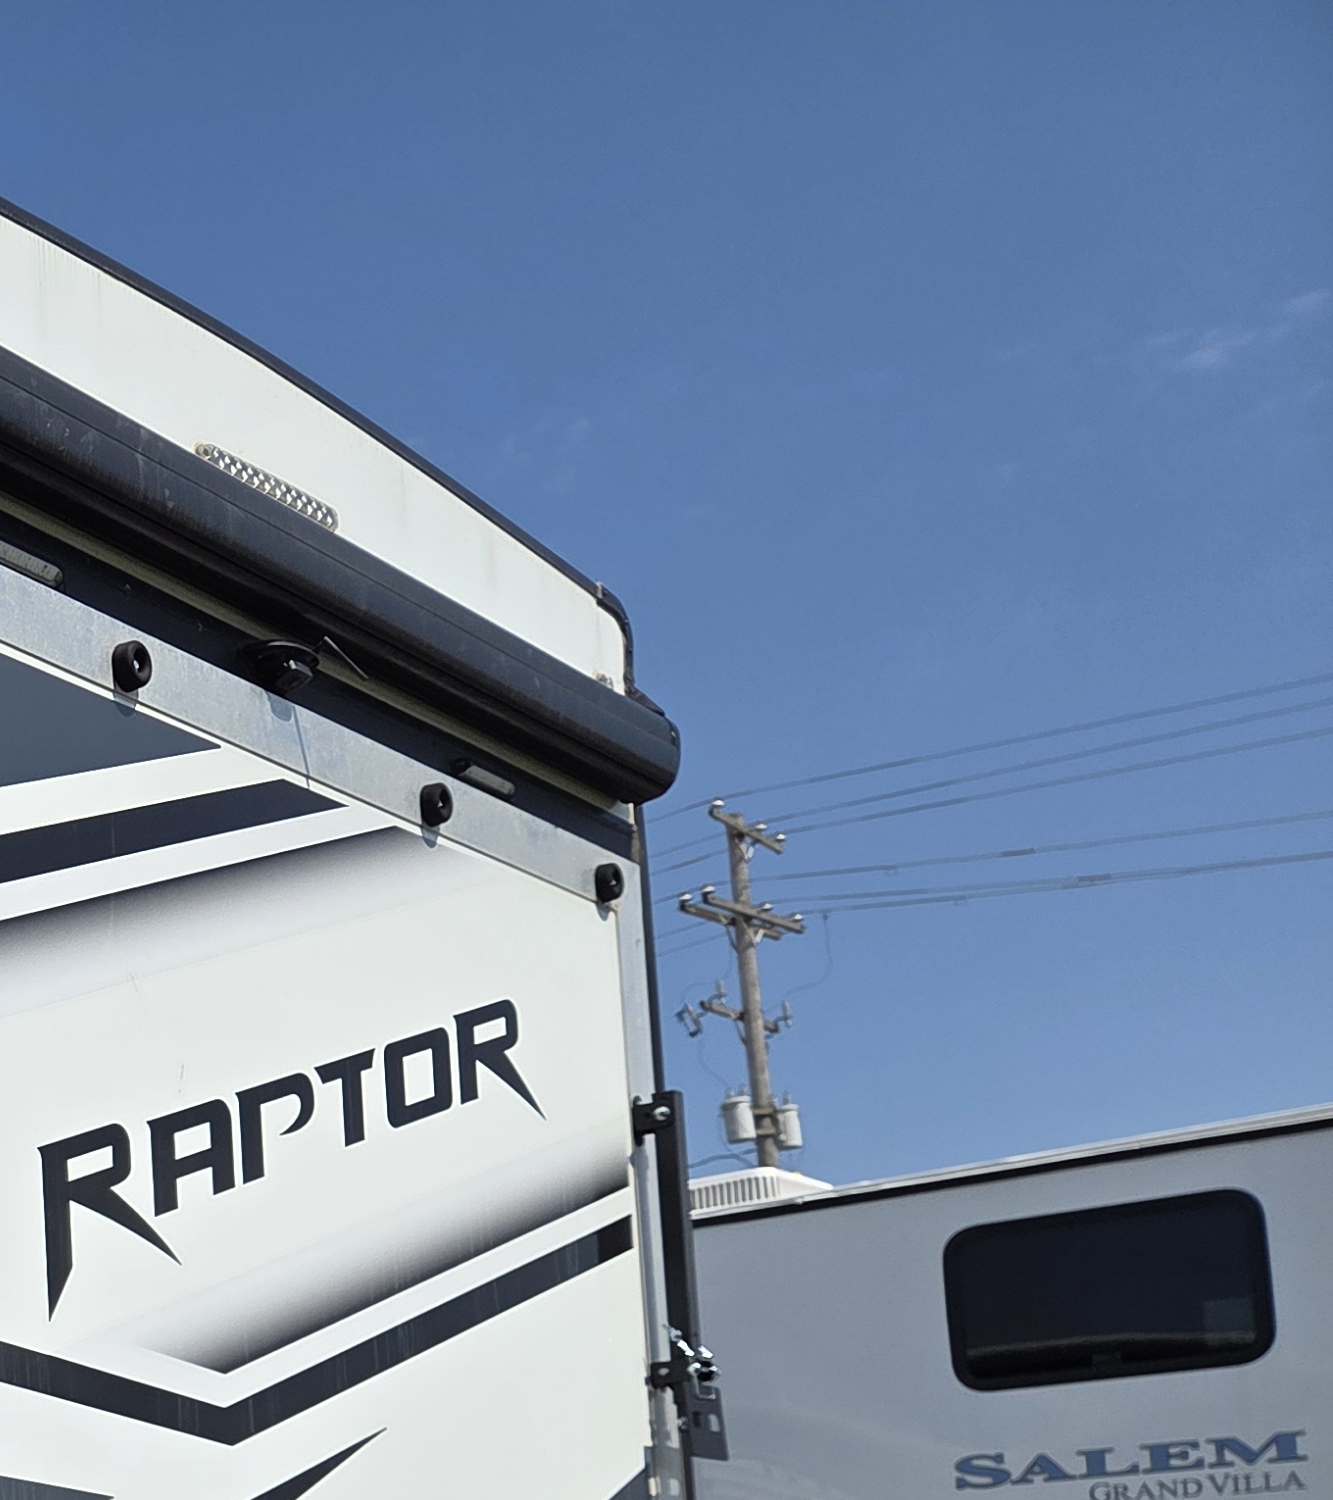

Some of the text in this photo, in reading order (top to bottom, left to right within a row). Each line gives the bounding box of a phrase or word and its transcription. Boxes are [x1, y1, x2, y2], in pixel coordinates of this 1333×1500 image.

[36, 998, 548, 1323] RAPTOR
[954, 1429, 1308, 1491] SALEM
[1206, 1469, 1308, 1496] VILLA
